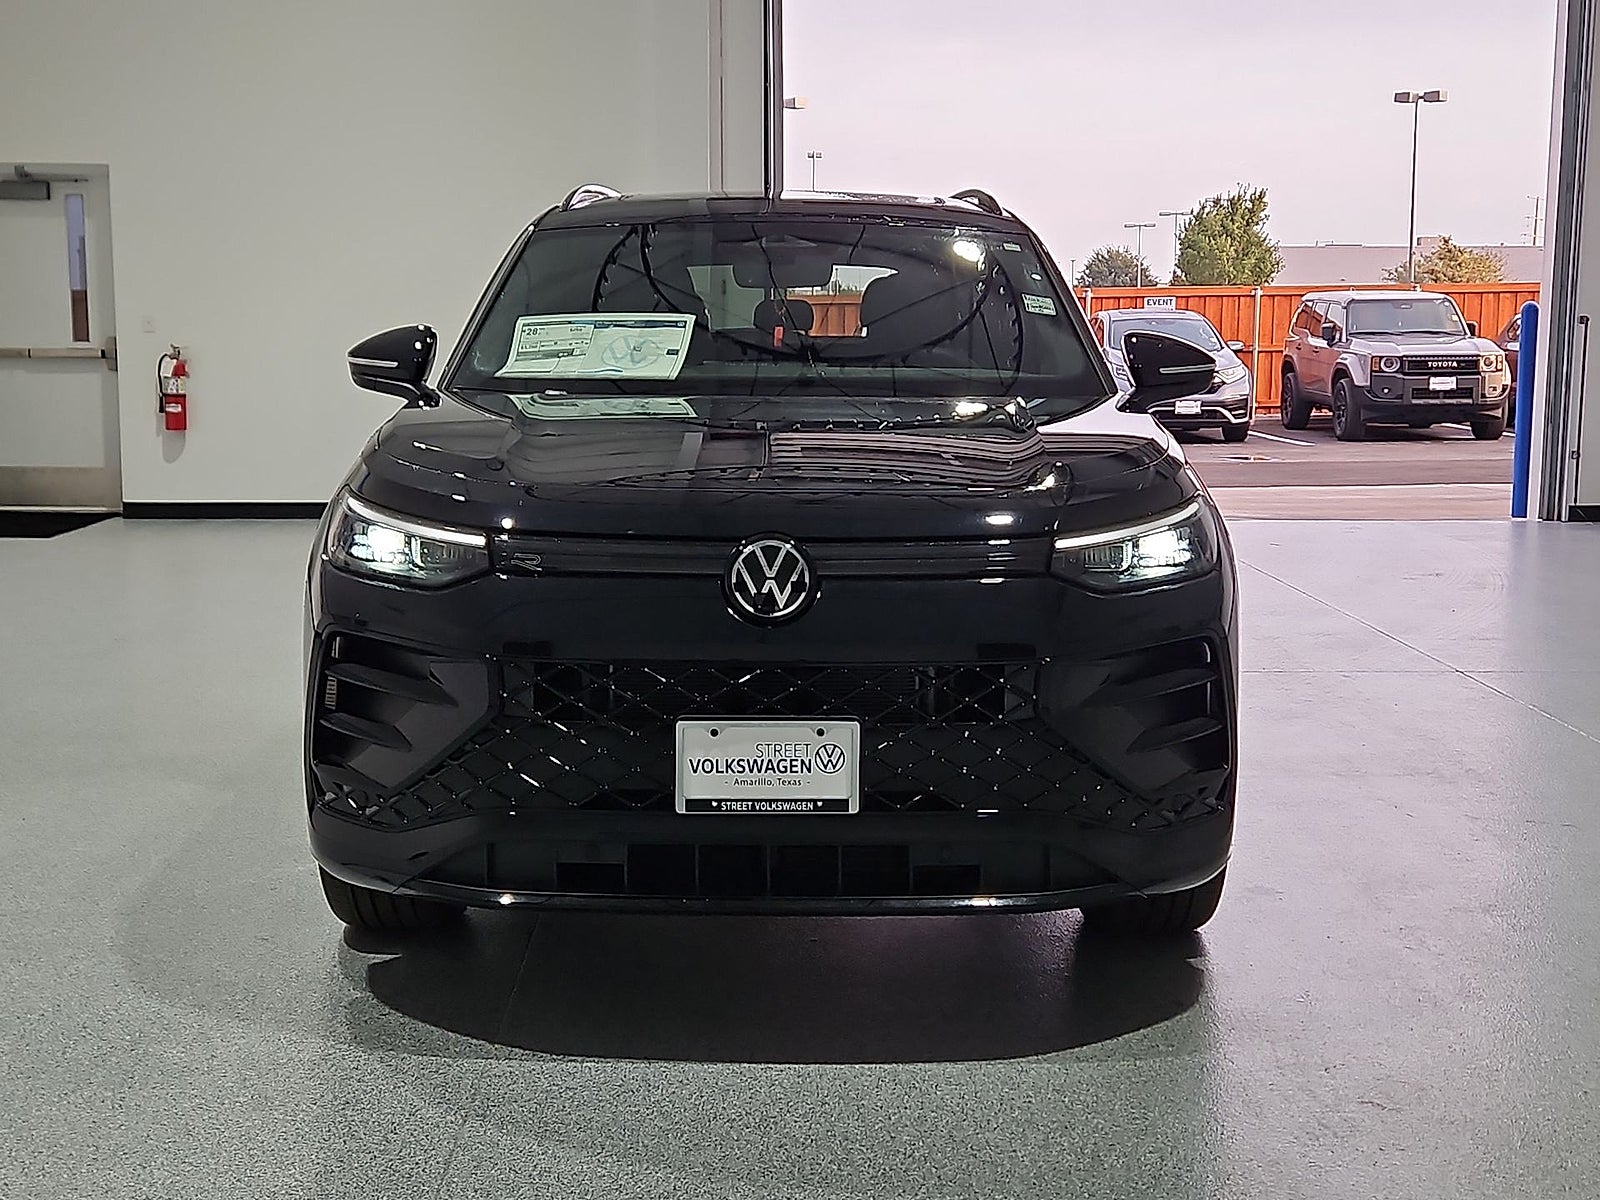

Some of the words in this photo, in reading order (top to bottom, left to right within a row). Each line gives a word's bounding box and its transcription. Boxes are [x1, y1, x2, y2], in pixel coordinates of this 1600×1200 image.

[1146, 298, 1174, 306] EVENT
[755, 743, 812, 758] STREET
[688, 758, 812, 774] VOLKSWAGEN
[733, 777, 775, 787] Amarillo,
[777, 777, 802, 786] Texas
[721, 801, 752, 811] STREET
[754, 801, 814, 811] VOLKSWAGEN
